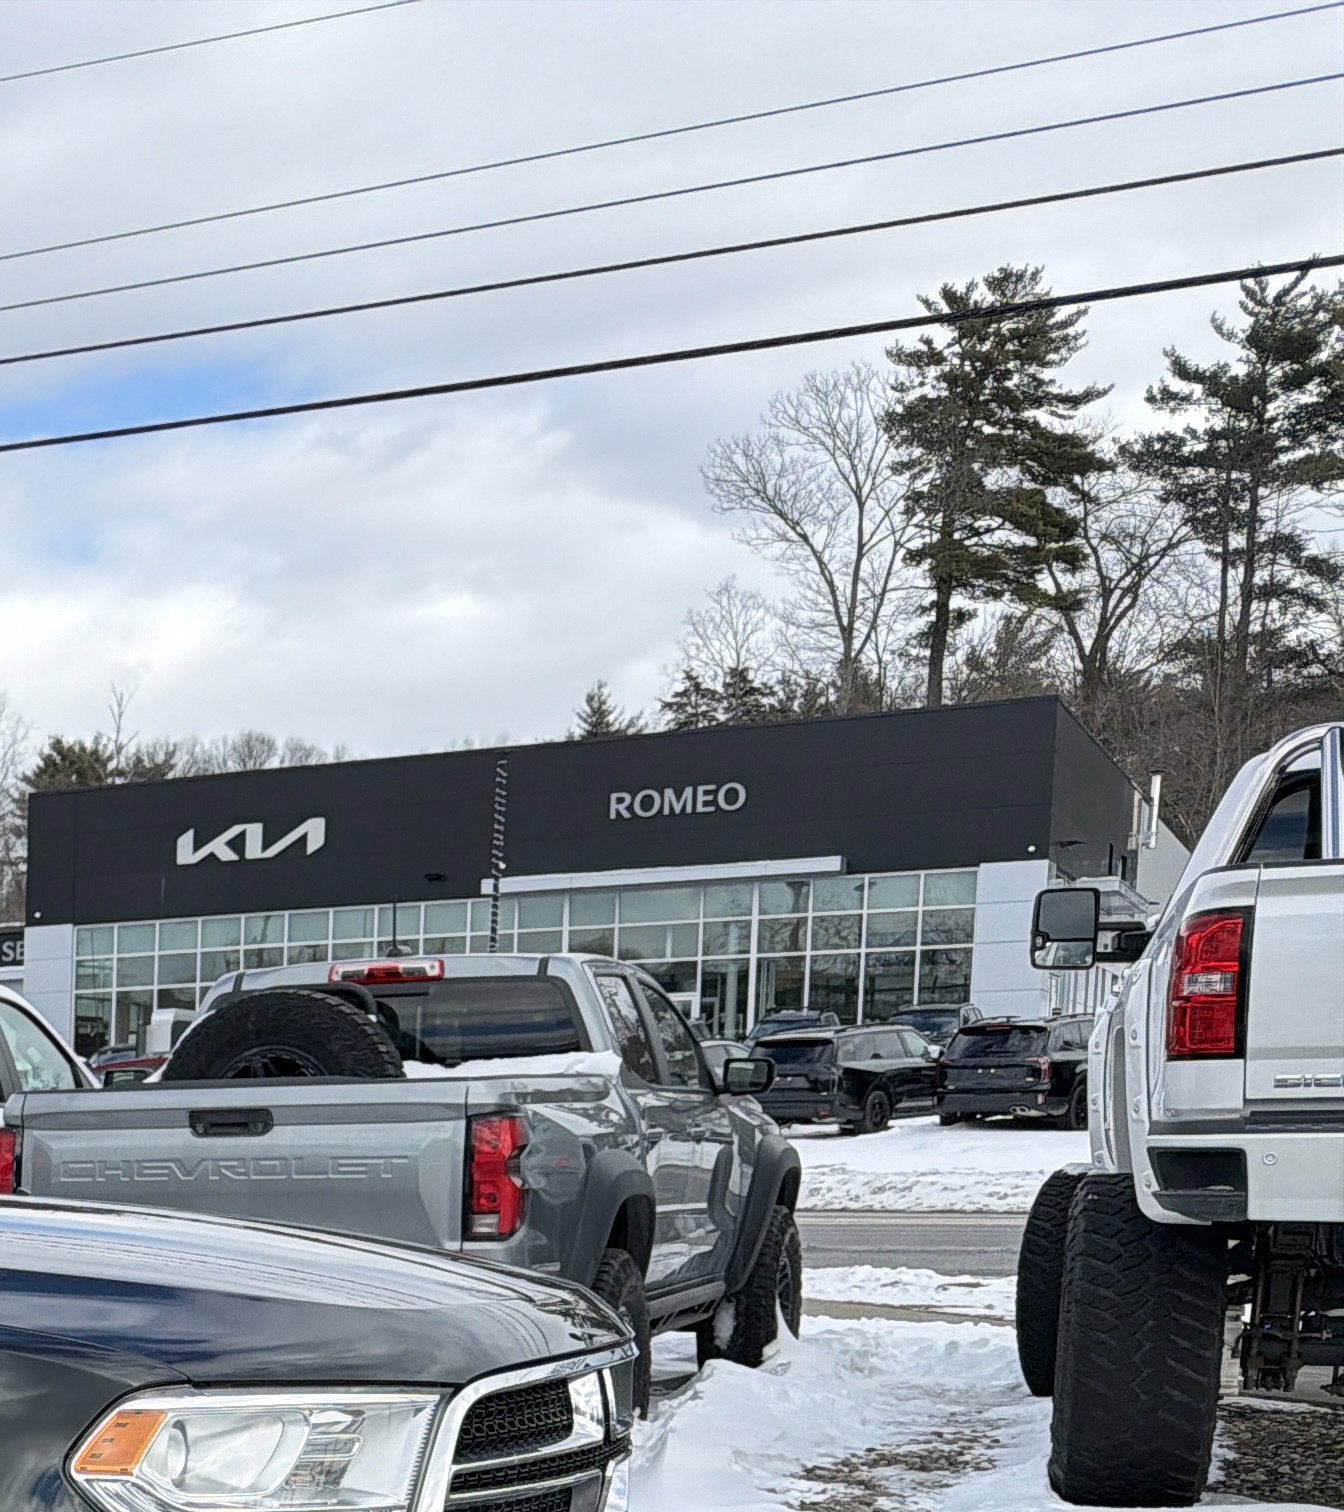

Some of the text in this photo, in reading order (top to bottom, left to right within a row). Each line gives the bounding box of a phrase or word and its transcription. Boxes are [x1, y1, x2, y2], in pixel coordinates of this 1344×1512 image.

[609, 782, 747, 820] ROMEO
[176, 816, 326, 866] KIA
[59, 1155, 410, 1183] CHEVROLET
